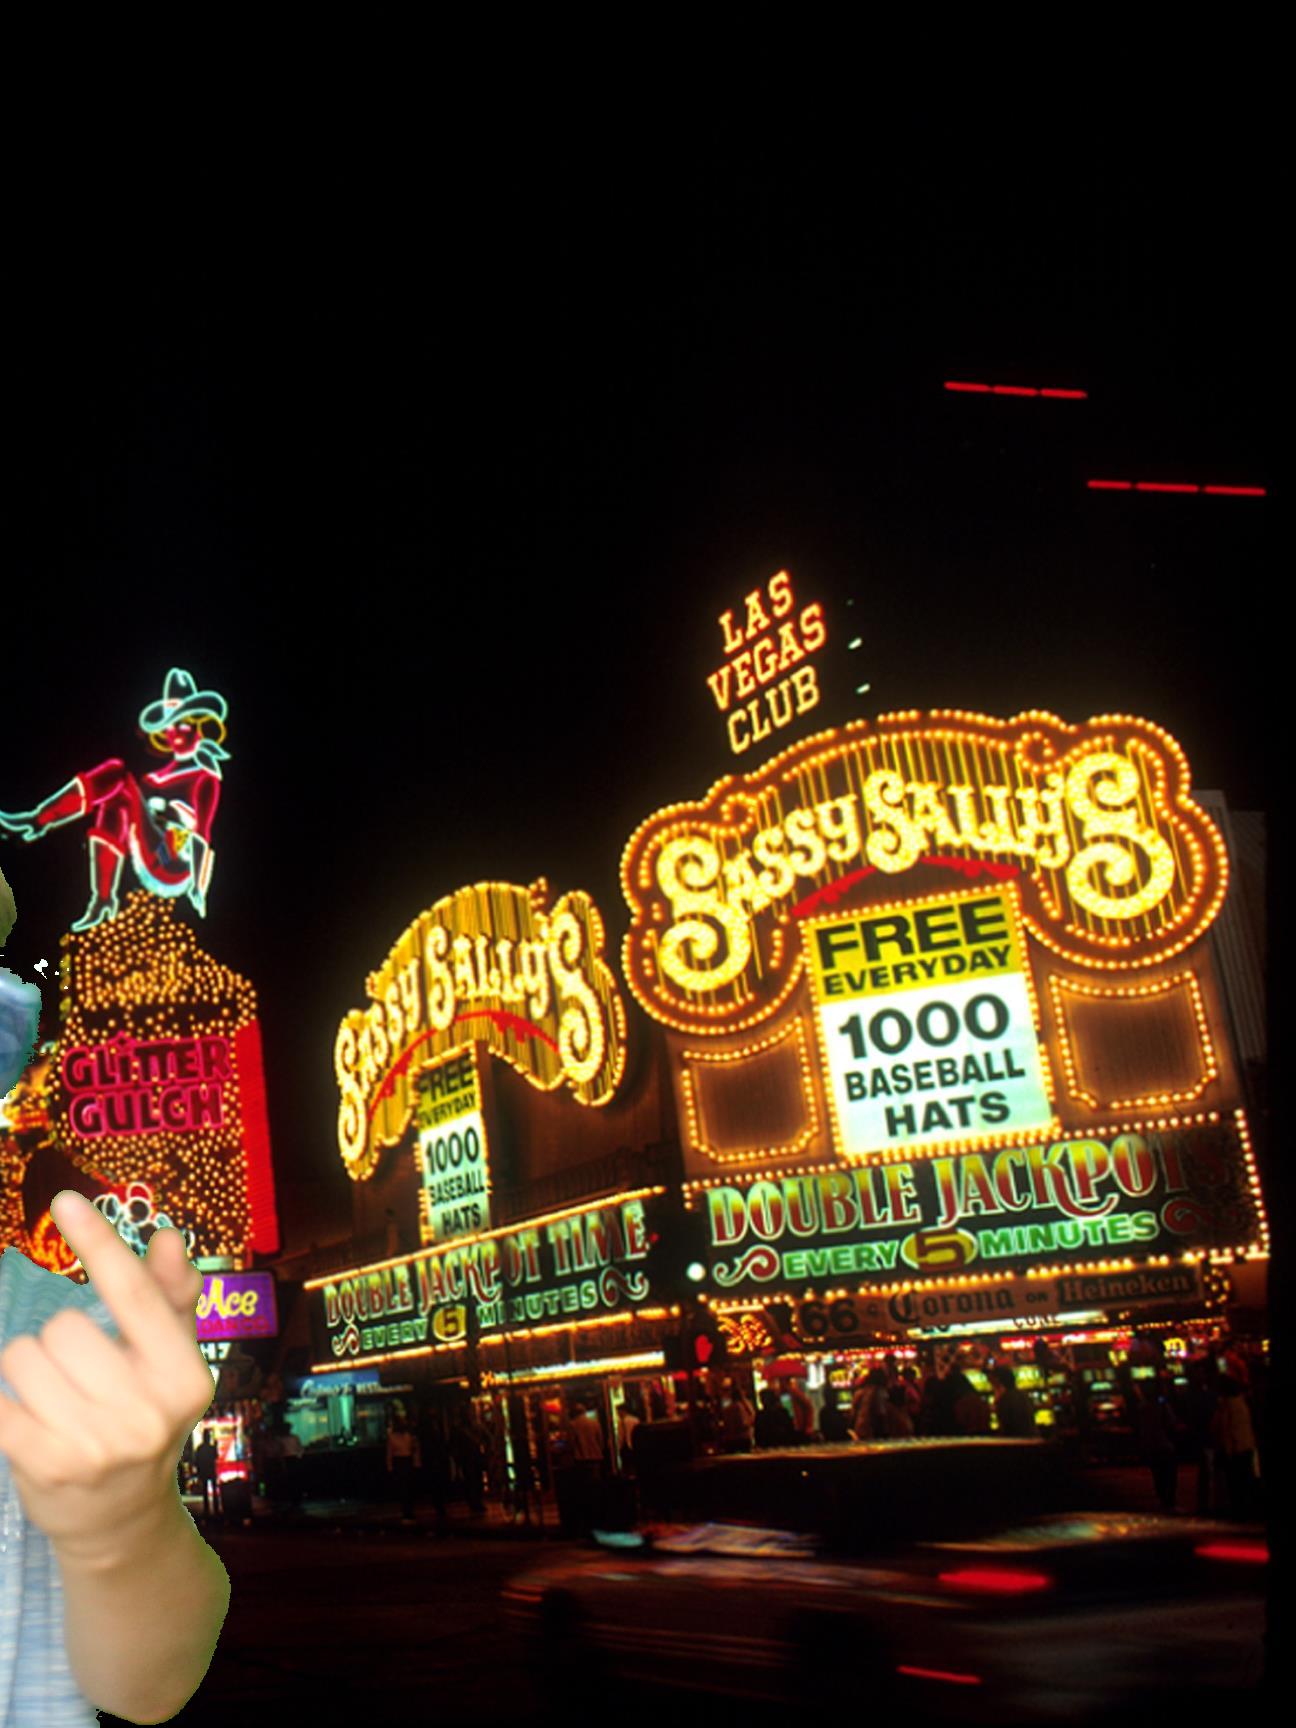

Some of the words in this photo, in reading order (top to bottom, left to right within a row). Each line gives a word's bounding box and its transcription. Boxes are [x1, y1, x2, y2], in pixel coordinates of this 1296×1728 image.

[719, 569, 795, 654] LAS
[706, 601, 827, 711] VEGAS
[726, 663, 820, 755] CLUB
[814, 895, 1009, 971] FREE
[822, 945, 1012, 997] EVERYDAY
[837, 993, 1011, 1060] 1000
[418, 1053, 475, 1101] FREE
[842, 1048, 1026, 1103] BASEBALL
[68, 1084, 225, 1139] GULCH
[884, 1092, 1010, 1138] HATS
[426, 1126, 480, 1175] 1000
[429, 1167, 485, 1206] BASEBALL
[705, 1161, 921, 1246] DOUBLE
[441, 1202, 482, 1235] HATS
[783, 1240, 902, 1281] EVERY
[915, 1232, 964, 1270] 5
[979, 1211, 1159, 1260] MINUTES
[323, 1262, 413, 1327] DOUBLE
[415, 1227, 540, 1317] JACKPOT
[547, 1199, 650, 1276] TIME
[362, 1318, 428, 1351] EVERY
[477, 1280, 598, 1328] MINUTES
[888, 1286, 1016, 1326] Corona
[1061, 1271, 1191, 1304] Heineken
